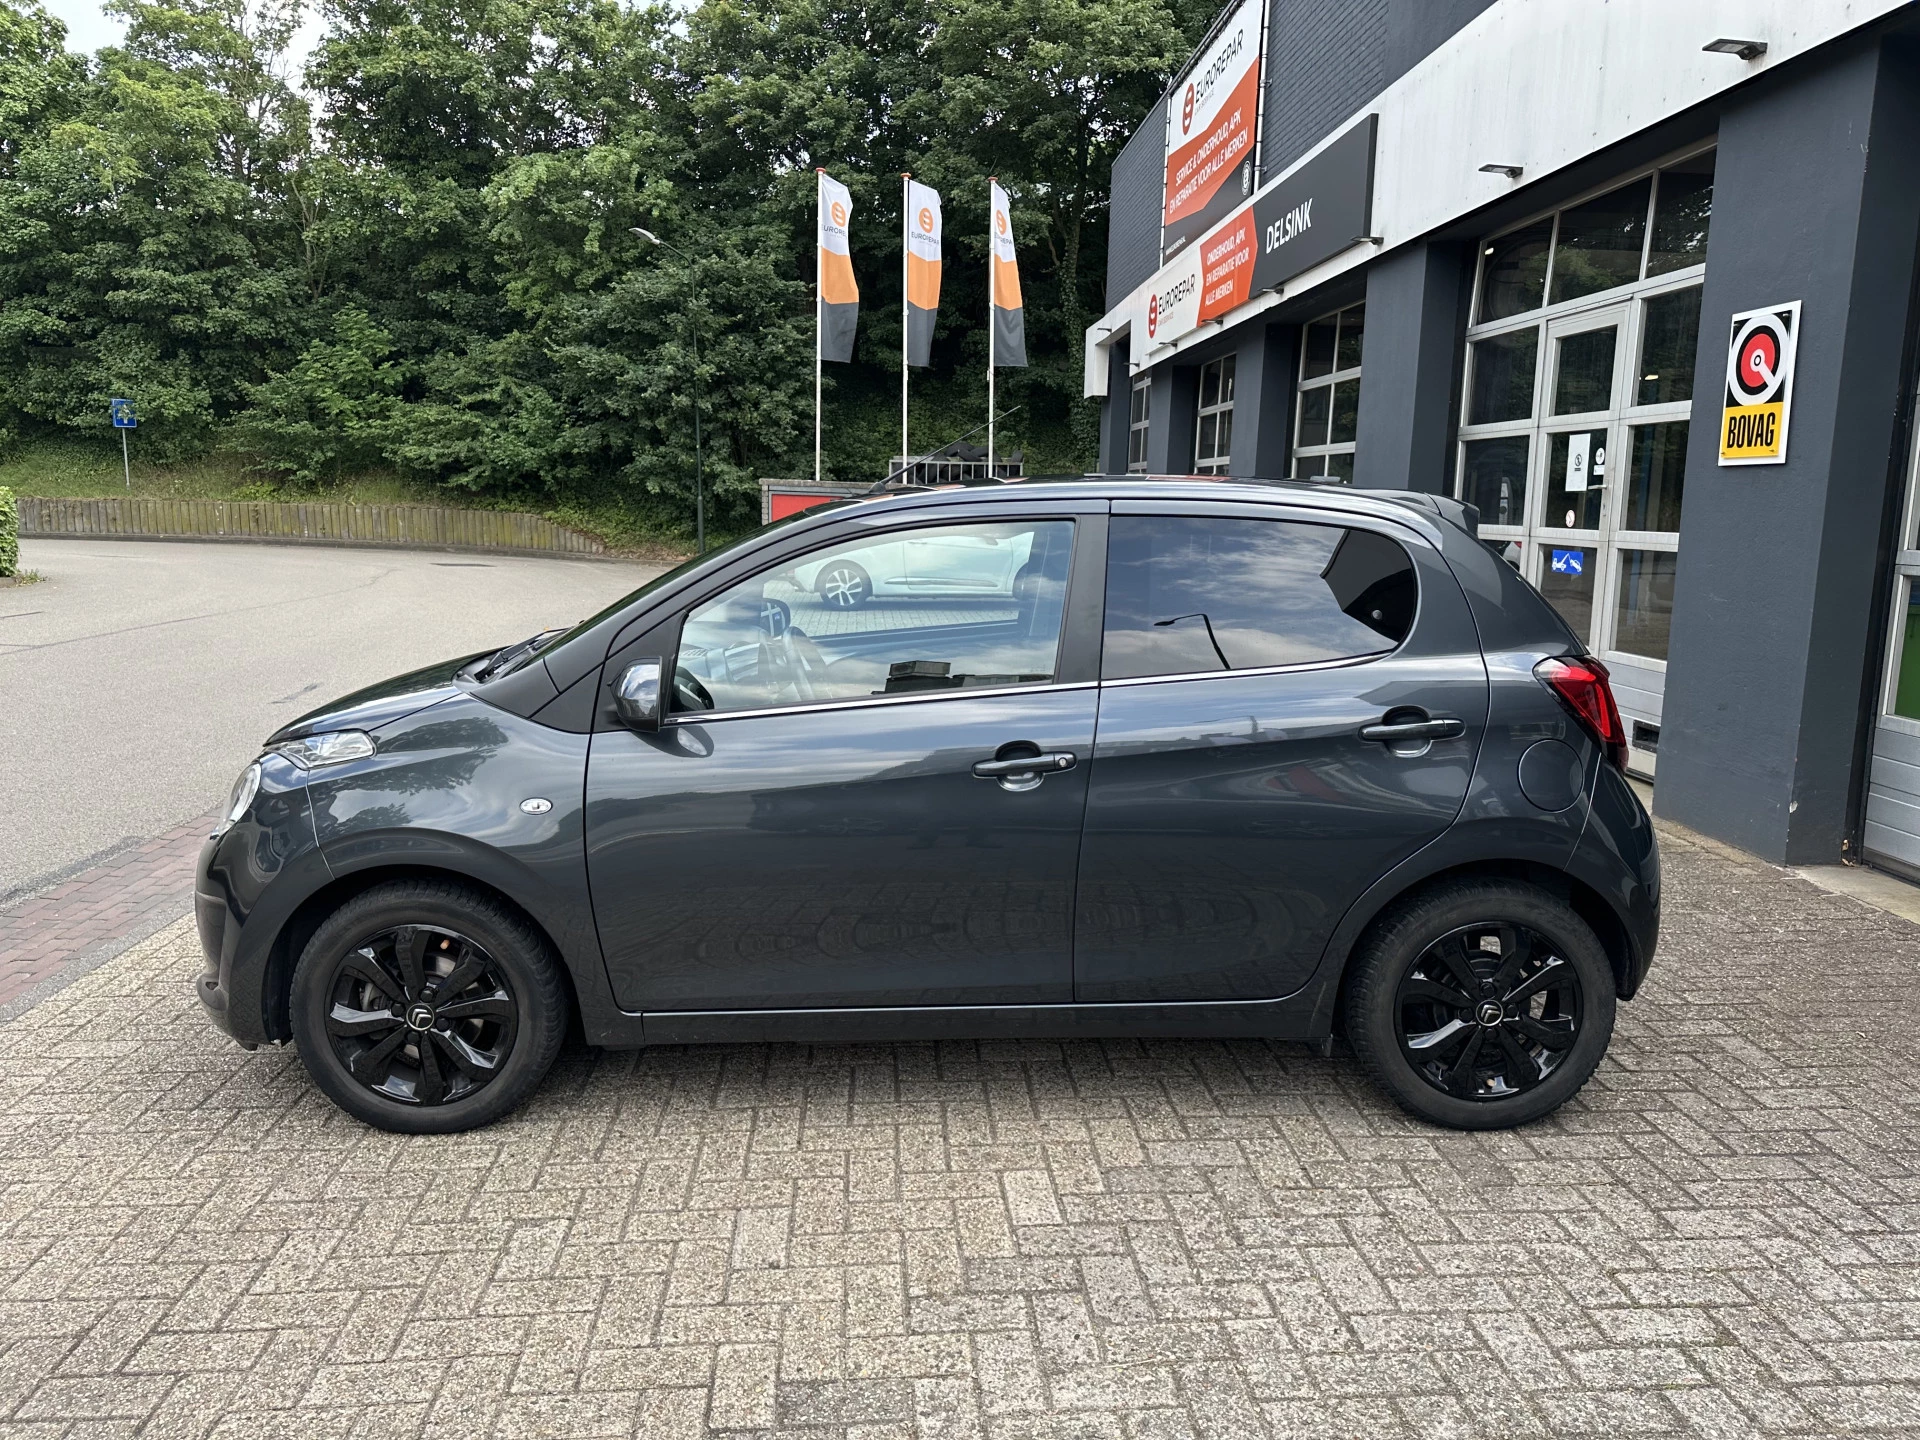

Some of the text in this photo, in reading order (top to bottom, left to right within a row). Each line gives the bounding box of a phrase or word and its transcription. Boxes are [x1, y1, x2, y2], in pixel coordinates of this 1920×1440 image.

[1196, 28, 1243, 104] EUROREPAR
[1175, 156, 1193, 187] SERVICE
[1196, 121, 1229, 164] ONDERHOUD,
[1228, 106, 1242, 133] APK
[1169, 196, 1175, 215] EN
[1175, 174, 1197, 208] REPARATIE
[1197, 162, 1212, 187] VOOR
[1211, 149, 1224, 176] ALLE
[1224, 126, 1248, 163] MERKEN
[1206, 235, 1235, 266] ONDERHOUD,
[1235, 227, 1246, 246] APK
[1266, 198, 1313, 254] DELSINK
[1205, 247, 1249, 287] EN REPARATIE VOOR
[1158, 273, 1196, 315] EUROREPAR
[1204, 278, 1234, 307] ALLE MERKEN
[1726, 412, 1776, 449] BOVAG
